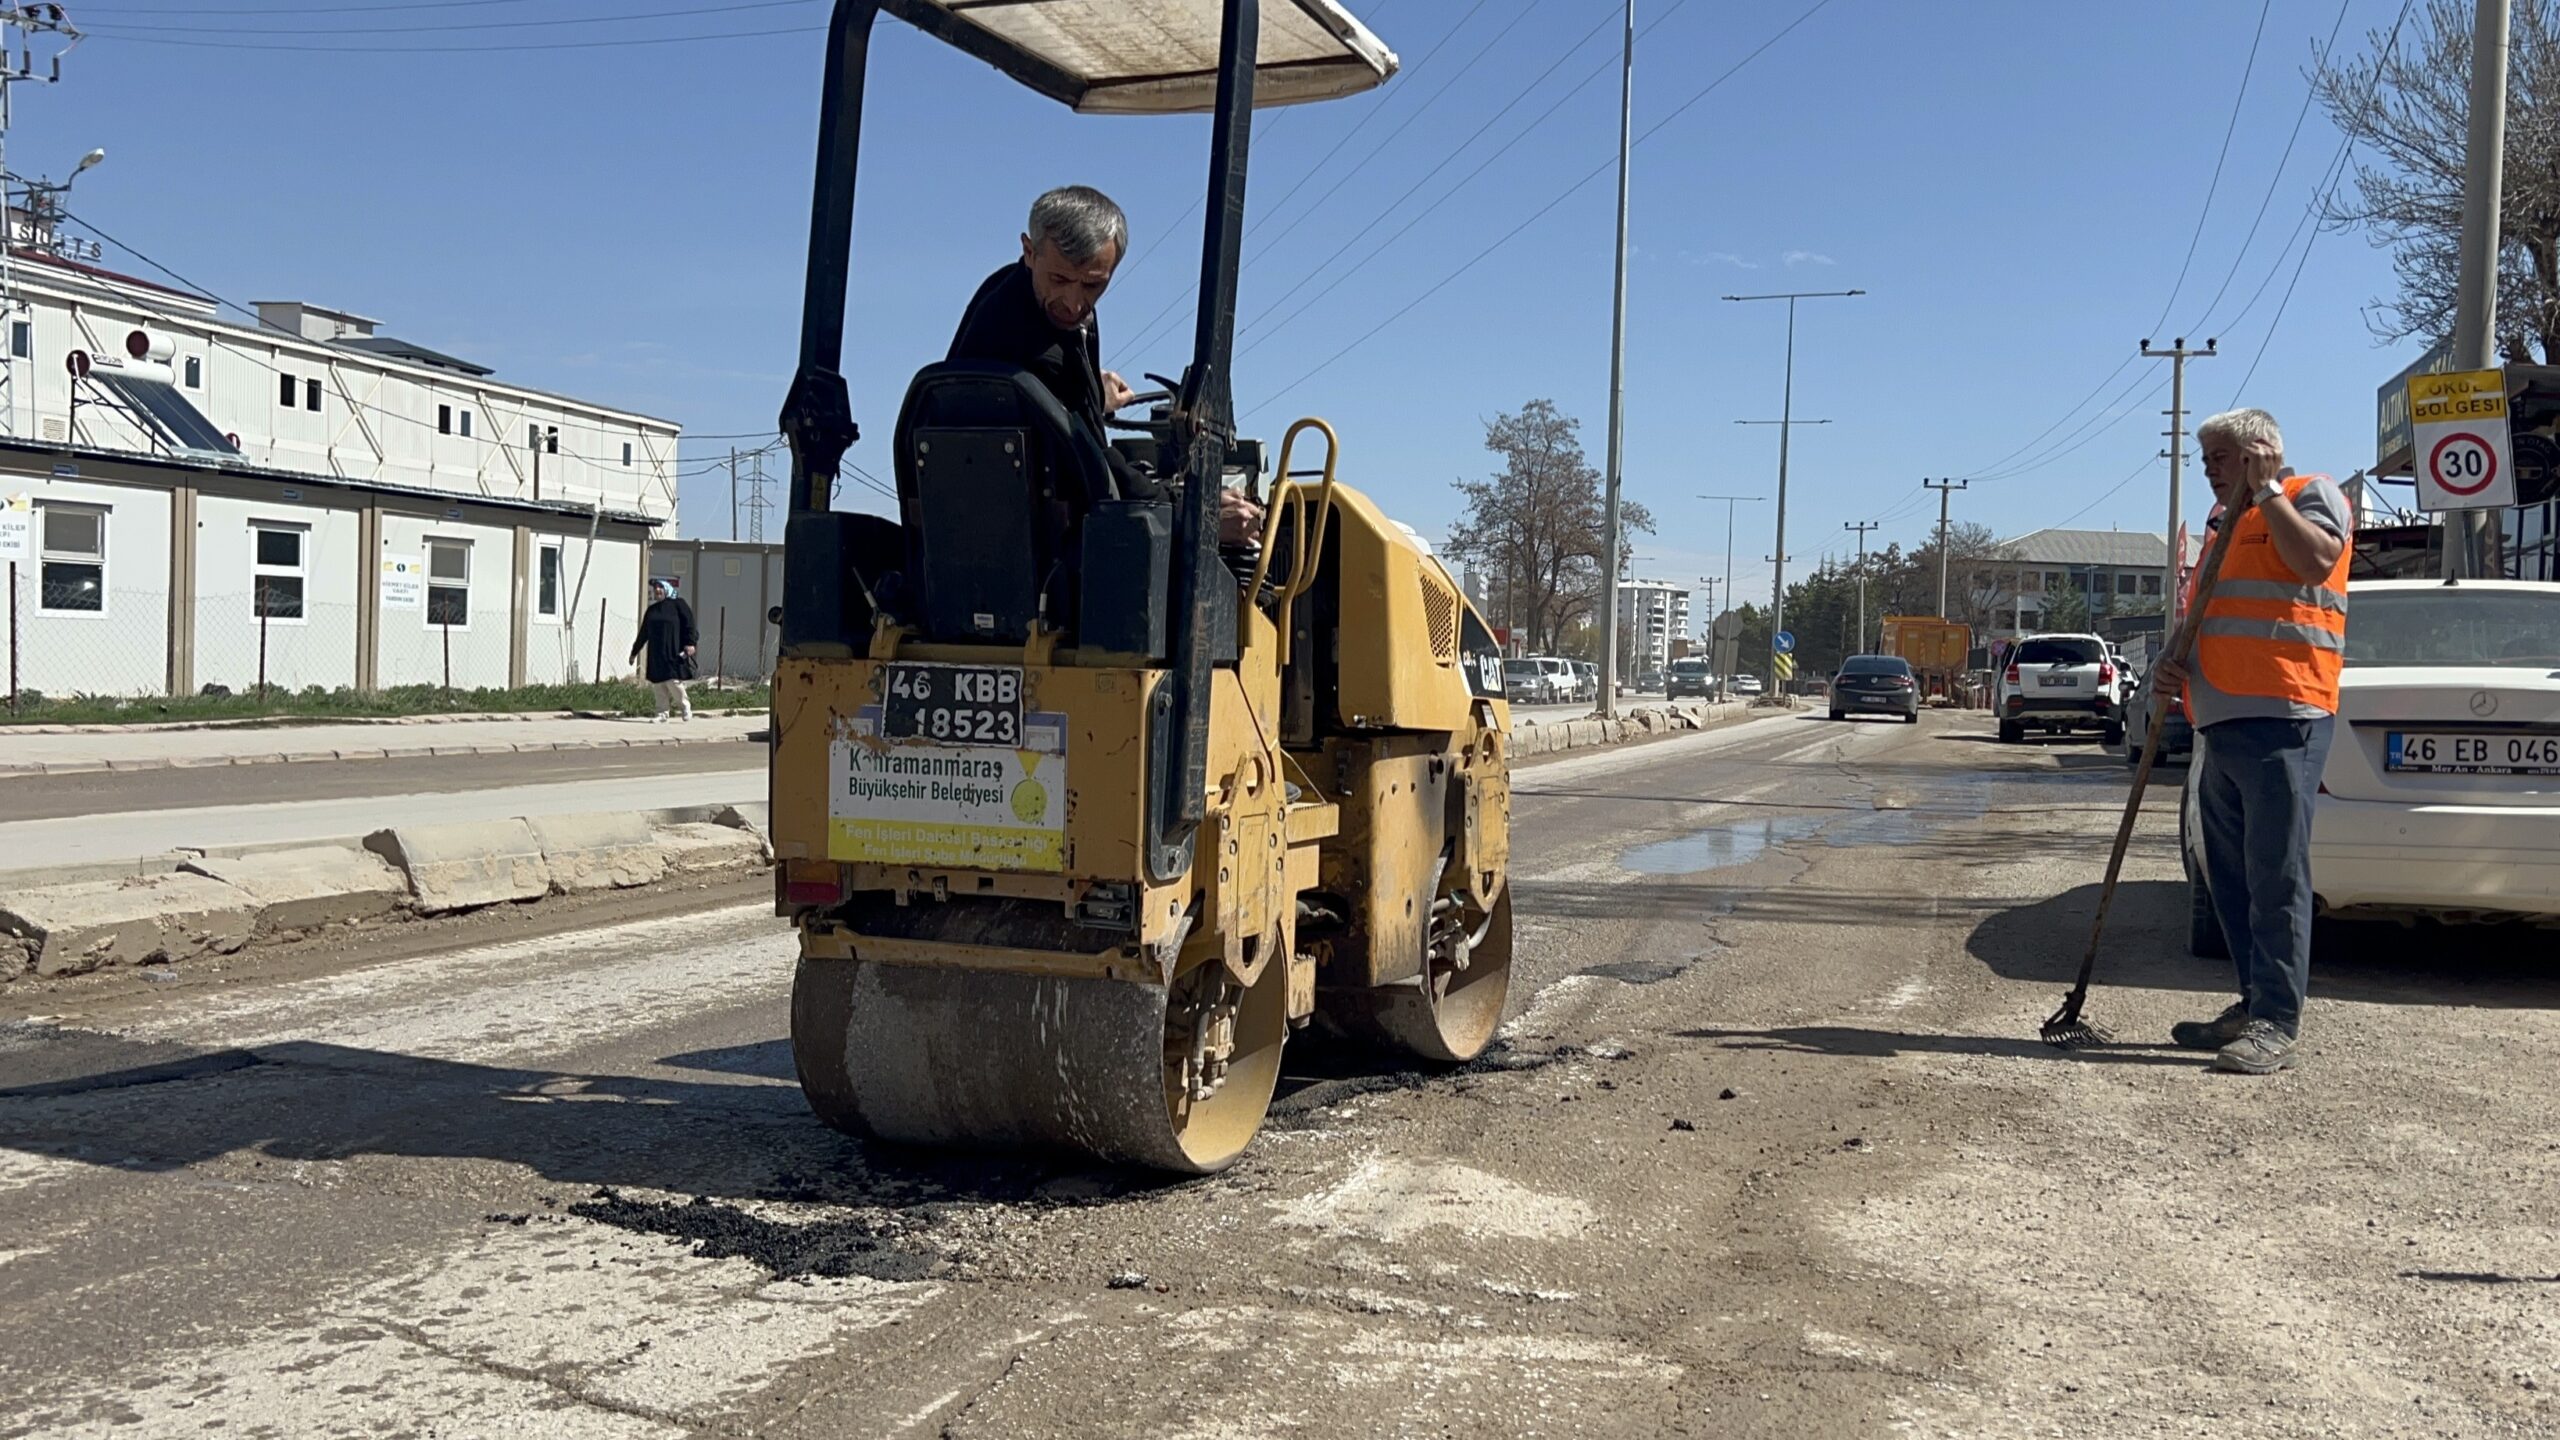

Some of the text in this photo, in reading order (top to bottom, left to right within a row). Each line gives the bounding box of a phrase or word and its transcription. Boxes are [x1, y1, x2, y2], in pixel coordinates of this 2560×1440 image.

[2444, 450, 2482, 478] 30
[1480, 654, 1502, 692] CAT
[892, 670, 1017, 704] 46 KBB
[914, 707, 1016, 741] 18523
[2390, 752, 2401, 760] TR
[2404, 738, 2558, 763] 46 EB 046
[2475, 765, 2512, 774] Ankara
[849, 777, 1004, 806] Büyükşehir Belediyesi
[845, 824, 872, 839] Fen
[864, 844, 887, 857] Fen
